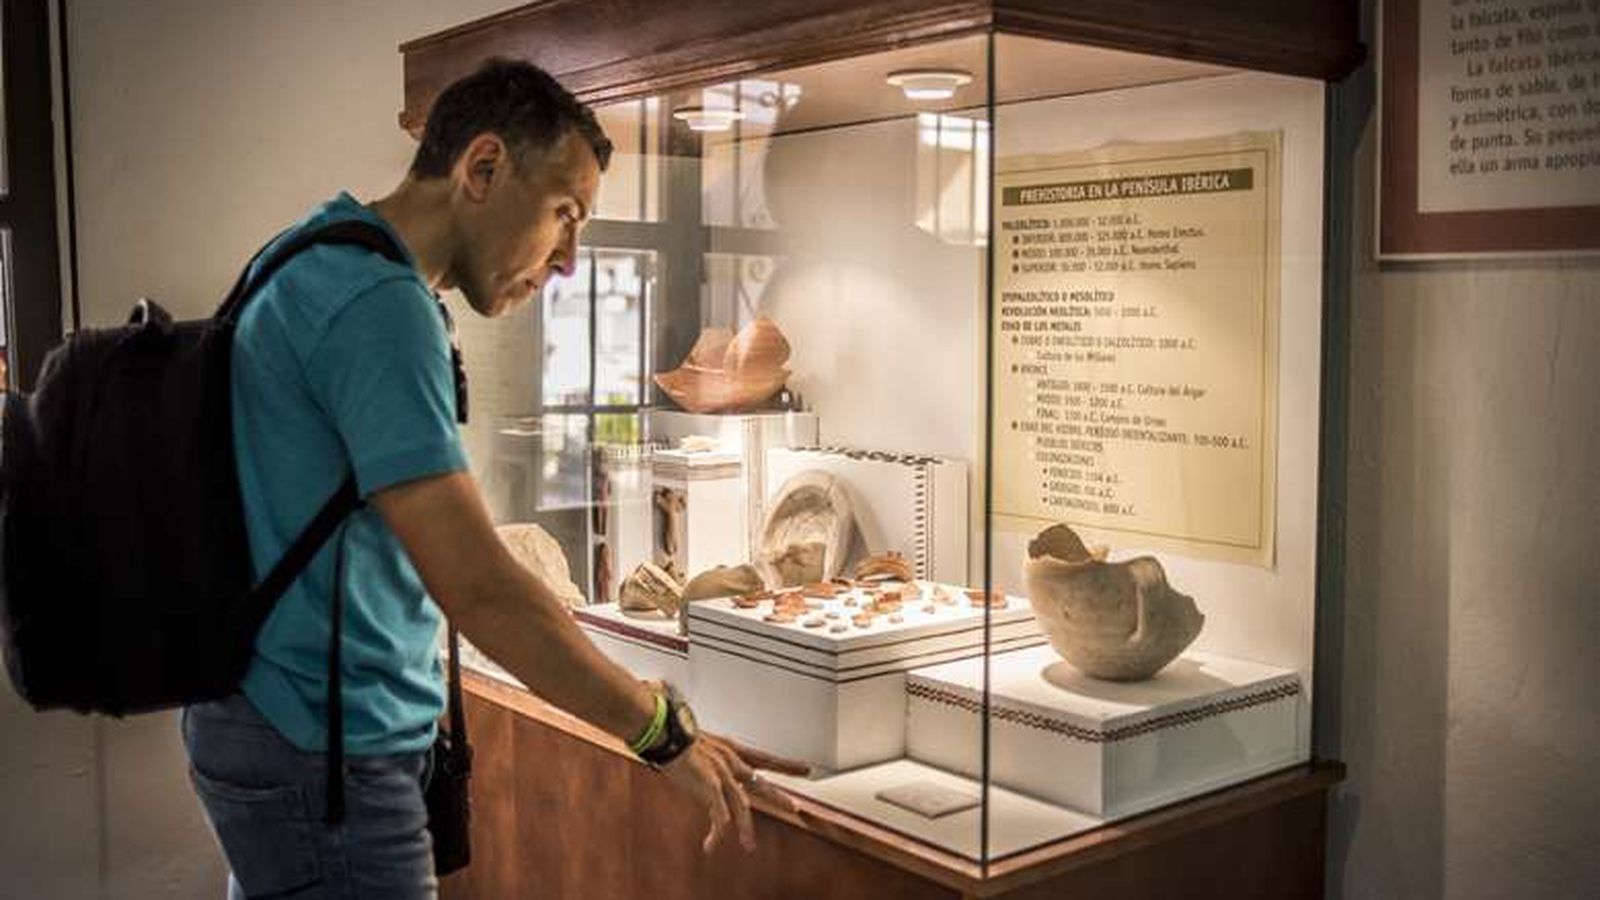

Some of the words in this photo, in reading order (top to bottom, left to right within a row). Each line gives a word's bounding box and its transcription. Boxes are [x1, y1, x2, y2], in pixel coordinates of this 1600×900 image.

[1450, 37, 1490, 56] tanto
[1494, 34, 1512, 49] de
[1467, 57, 1483, 77] La
[1488, 54, 1542, 74] falcata
[1450, 85, 1490, 103] forma
[1495, 83, 1513, 98] de
[1566, 72, 1587, 90] de
[1548, 102, 1577, 119] con
[1450, 134, 1466, 151] de
[1472, 133, 1518, 154] punta.
[1480, 158, 1498, 173] un
[1503, 156, 1540, 171] arma
[1019, 186, 1086, 204] PREHISTORIA
[1089, 183, 1102, 199] EN
[1105, 180, 1119, 198] LA
[1181, 173, 1231, 192] IBÉRICA
[1023, 320, 1032, 331] DE
